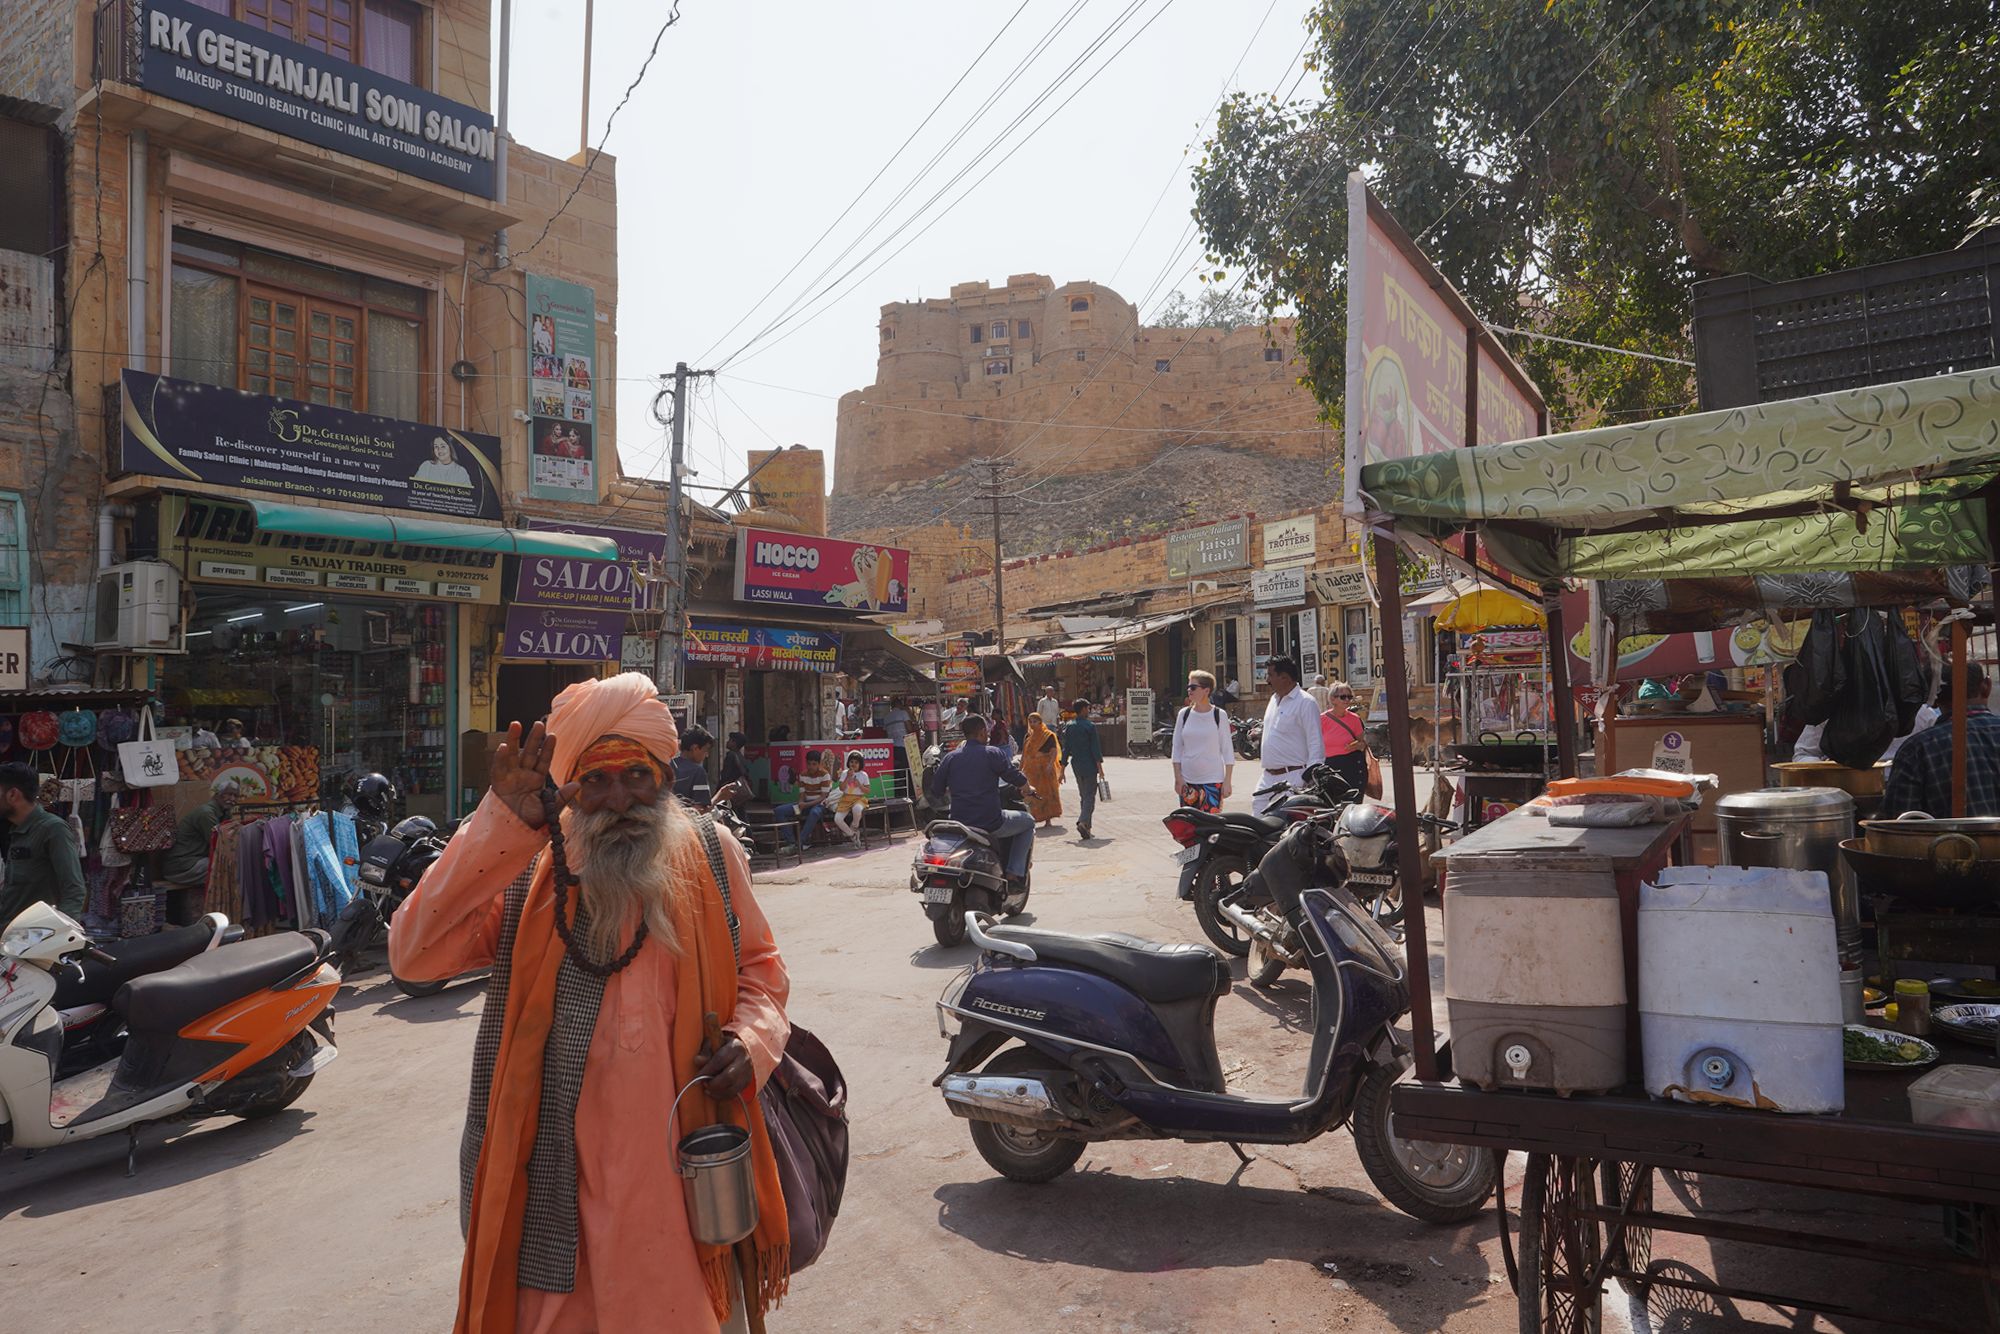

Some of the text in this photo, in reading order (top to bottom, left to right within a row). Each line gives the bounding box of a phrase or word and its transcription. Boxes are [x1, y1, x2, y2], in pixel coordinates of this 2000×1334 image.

[149, 9, 495, 161] RK GEETANJALI SONI SALON
[175, 66, 472, 174] MAKEUP STUDIO BEAUTY CLINIC NAIL ART STUDIO ACADEMY
[215, 436, 381, 472] Re-discover yourself in a new way
[179, 448, 408, 488] Family Salon Clinic Makeup Studio Beauty Academy Beauty Products
[241, 475, 283, 488] Jaisalmer
[285, 481, 315, 492] Branch
[321, 487, 336, 496] +91
[1211, 523, 1243, 535] Italiano
[1197, 533, 1241, 552] Jaisal
[1269, 534, 1310, 549] TROTTERS
[756, 542, 820, 571] HOCCO
[1202, 549, 1236, 563] Italy
[212, 566, 246, 576] DRY FRUITS
[290, 555, 407, 575] SANJAY TRADERS
[280, 569, 306, 577] GUJARATI
[286, 577, 314, 585] PRODUCTS
[1258, 580, 1300, 593] TROTTERS
[538, 591, 574, 601] MAKE-UP
[580, 593, 598, 602] HAIR
[603, 594, 620, 603] NAIL
[751, 588, 793, 600] LASSI WALA
[720, 629, 749, 642] लस्सी
[786, 632, 819, 646] स्पेशल
[518, 630, 612, 656] SALON
[813, 647, 836, 661] लस्सी
[861, 748, 890, 759] HOCCO
[285, 993, 320, 1024] Pleasure
